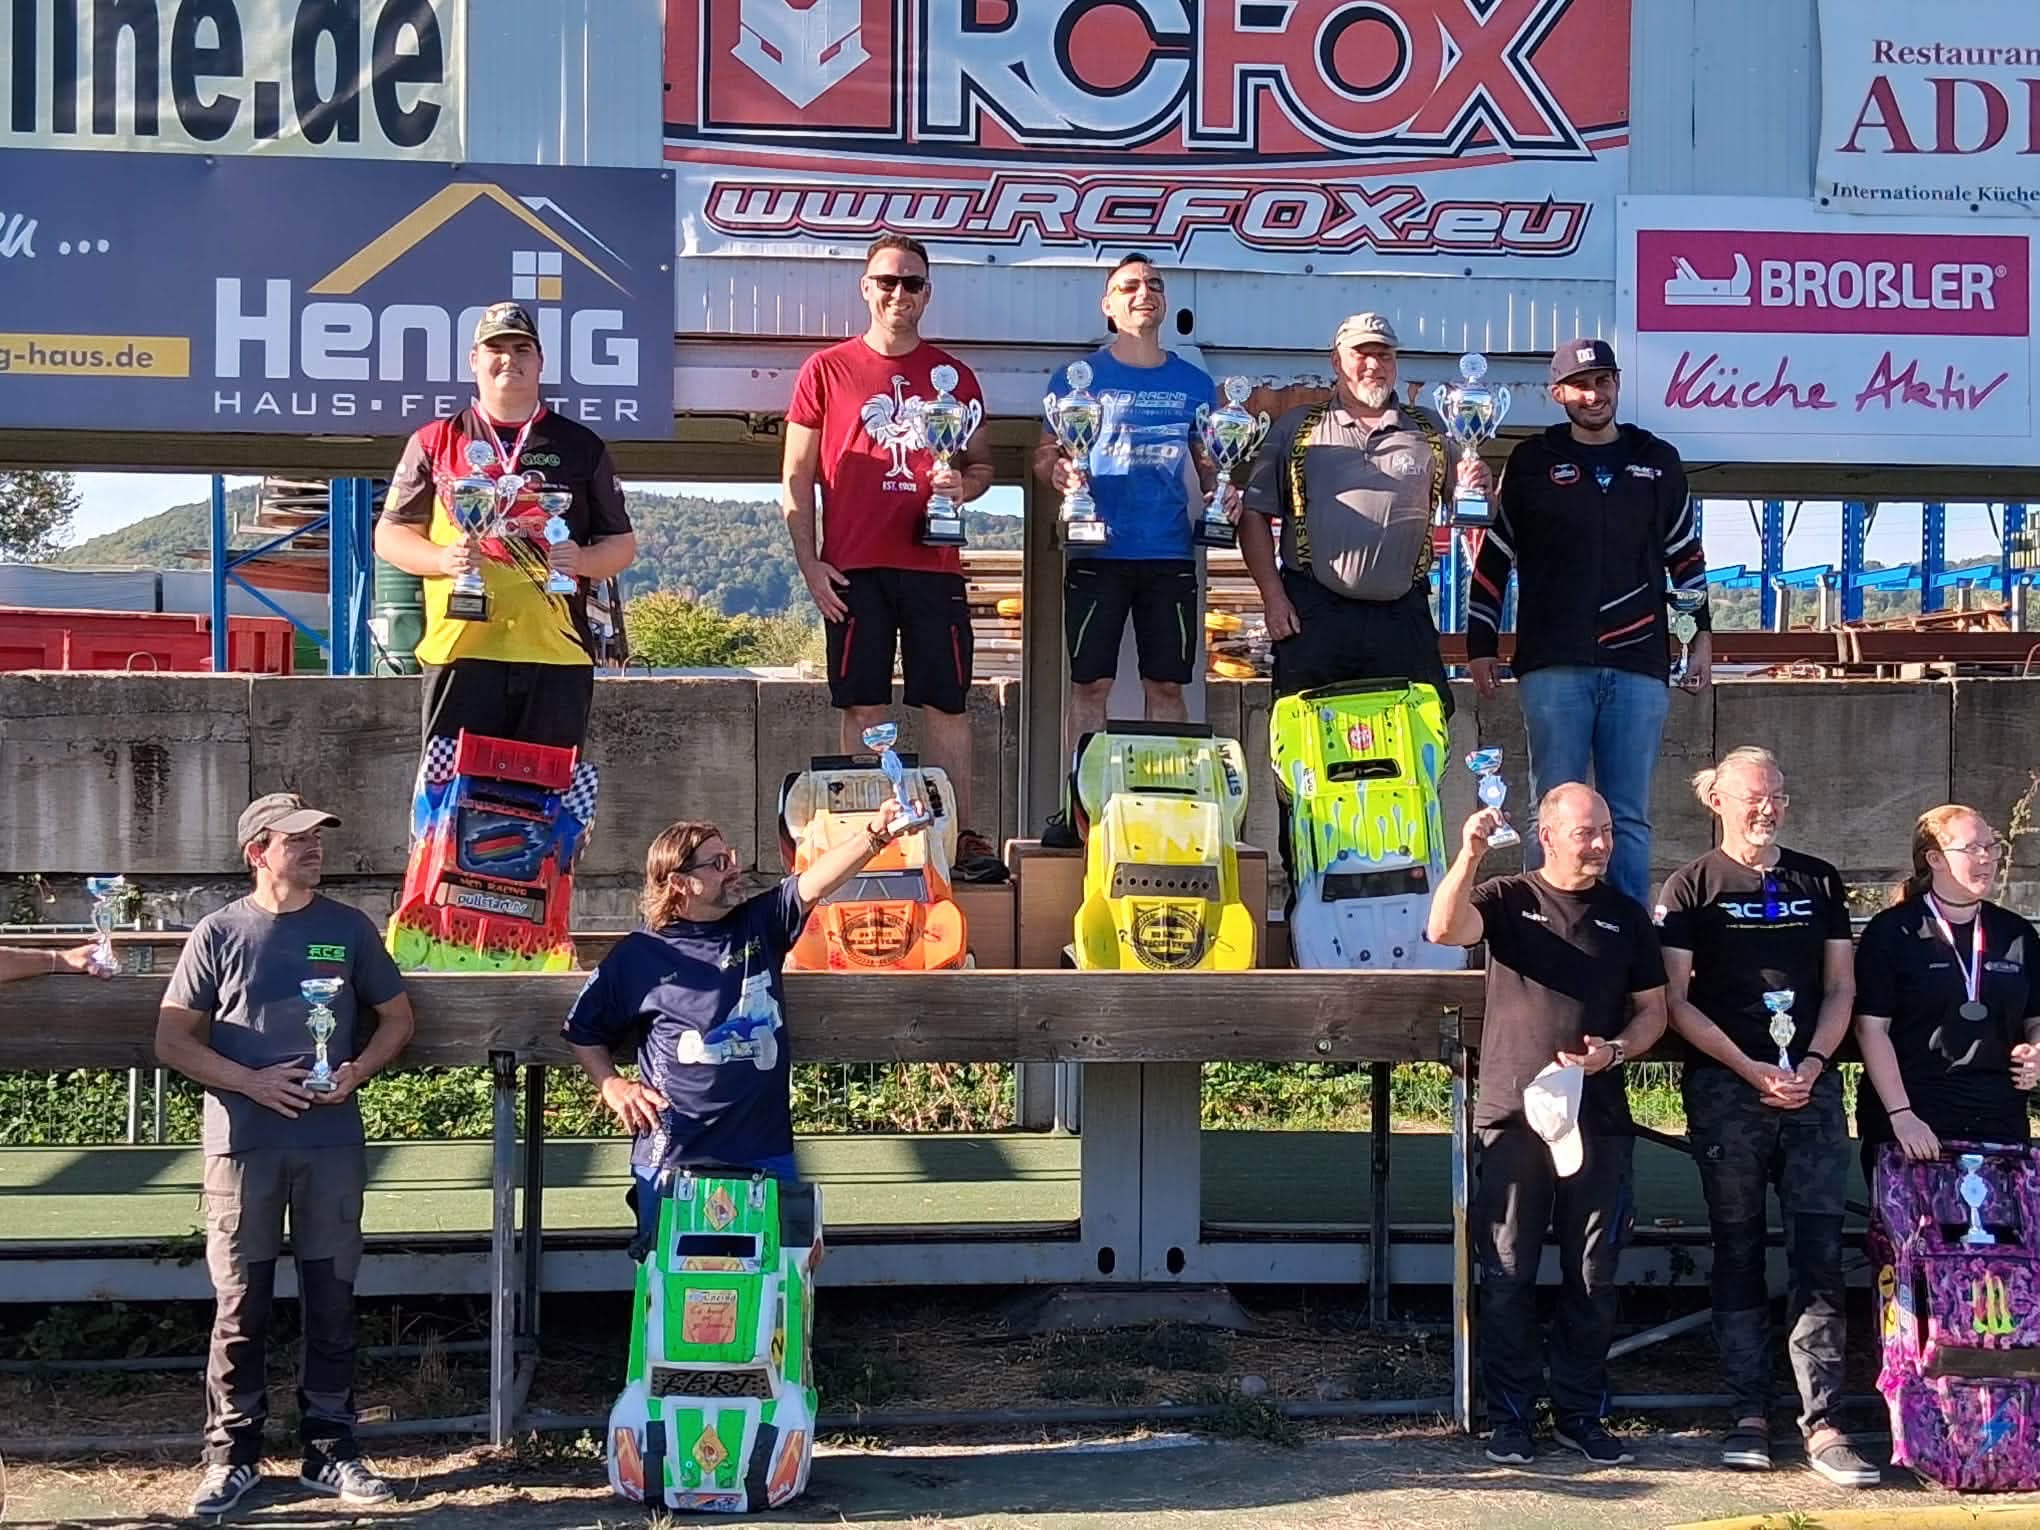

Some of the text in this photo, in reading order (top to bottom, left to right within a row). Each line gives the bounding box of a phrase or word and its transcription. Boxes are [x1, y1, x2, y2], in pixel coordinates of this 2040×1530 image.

[914, 0, 1597, 161] RCFOX
[1832, 182, 1972, 201] Internationale
[1664, 351, 2009, 412] Küche Aktiv
[214, 391, 356, 416] HAUS
